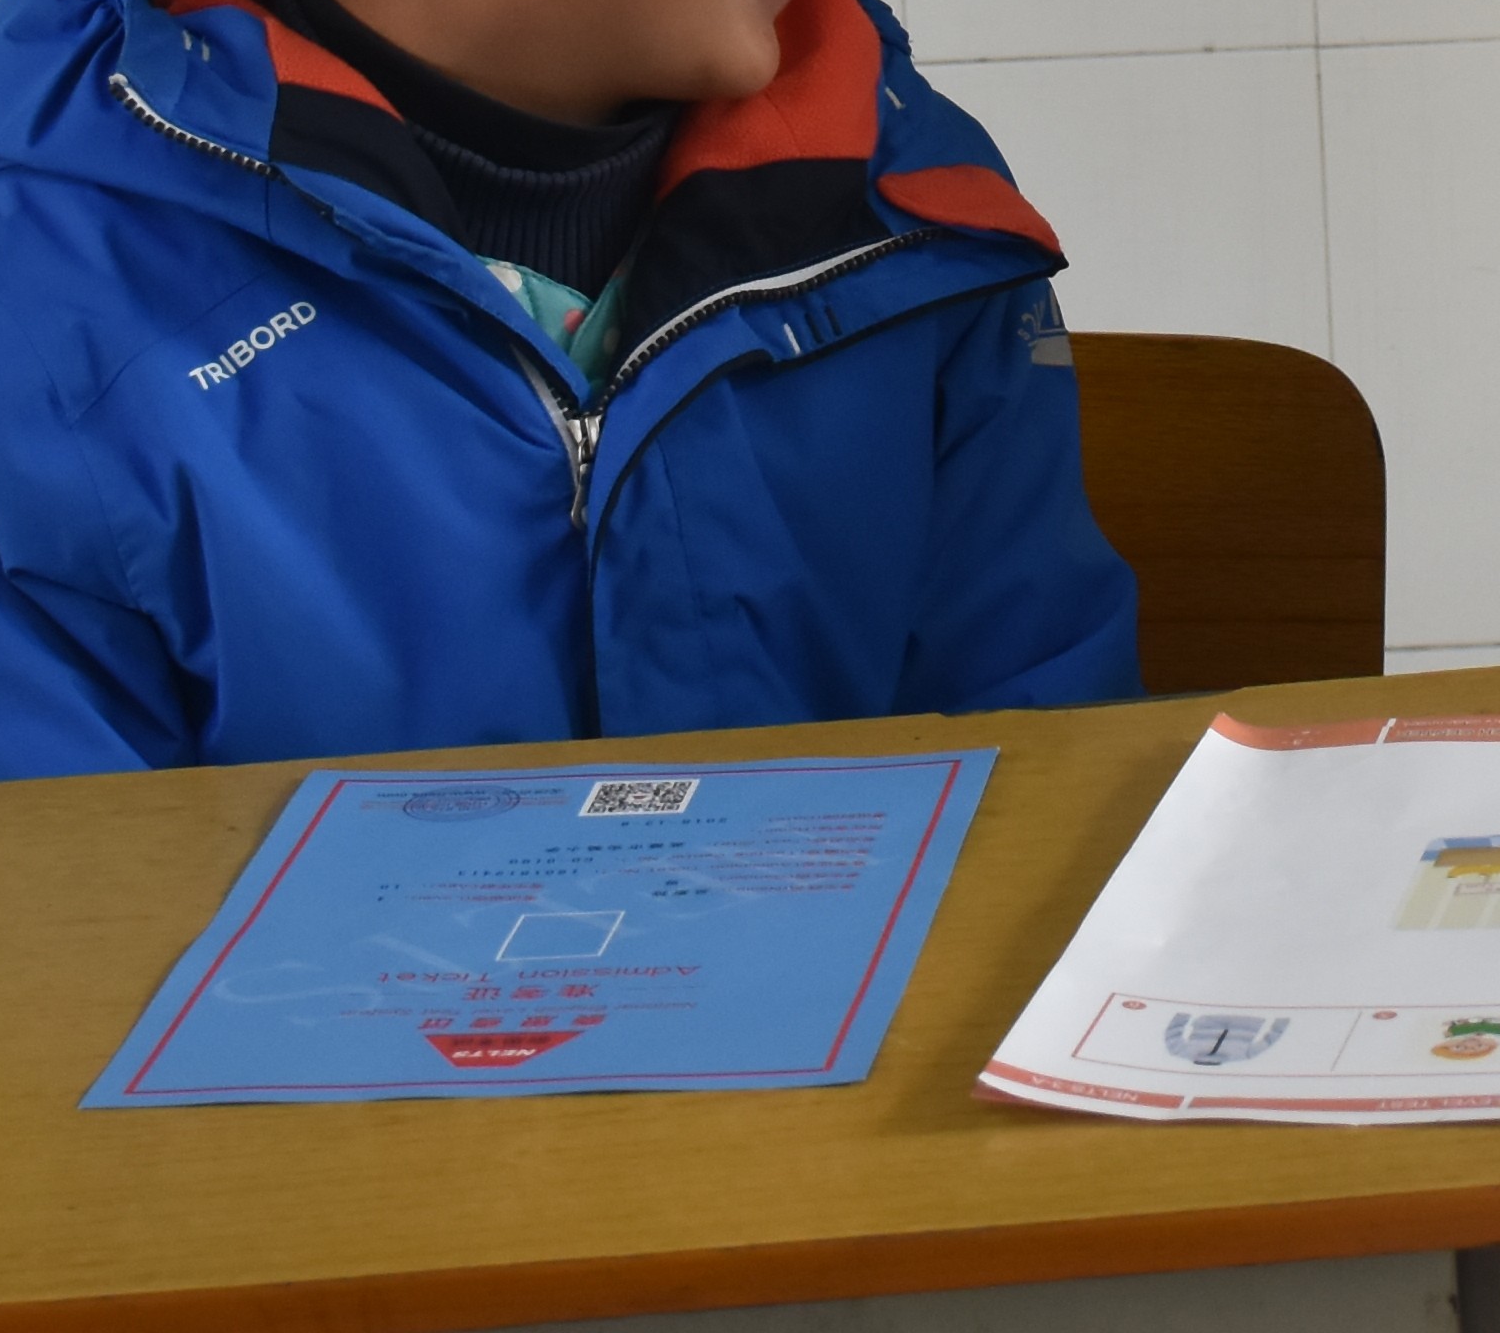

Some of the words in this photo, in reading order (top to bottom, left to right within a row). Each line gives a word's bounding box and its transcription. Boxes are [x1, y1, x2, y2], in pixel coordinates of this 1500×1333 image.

[187, 300, 318, 391] TRIBORD
[377, 972, 492, 985] Ticket
[517, 965, 701, 980] Admission
[452, 1048, 536, 1059] NELTS
[1376, 1099, 1435, 1109] TEST
